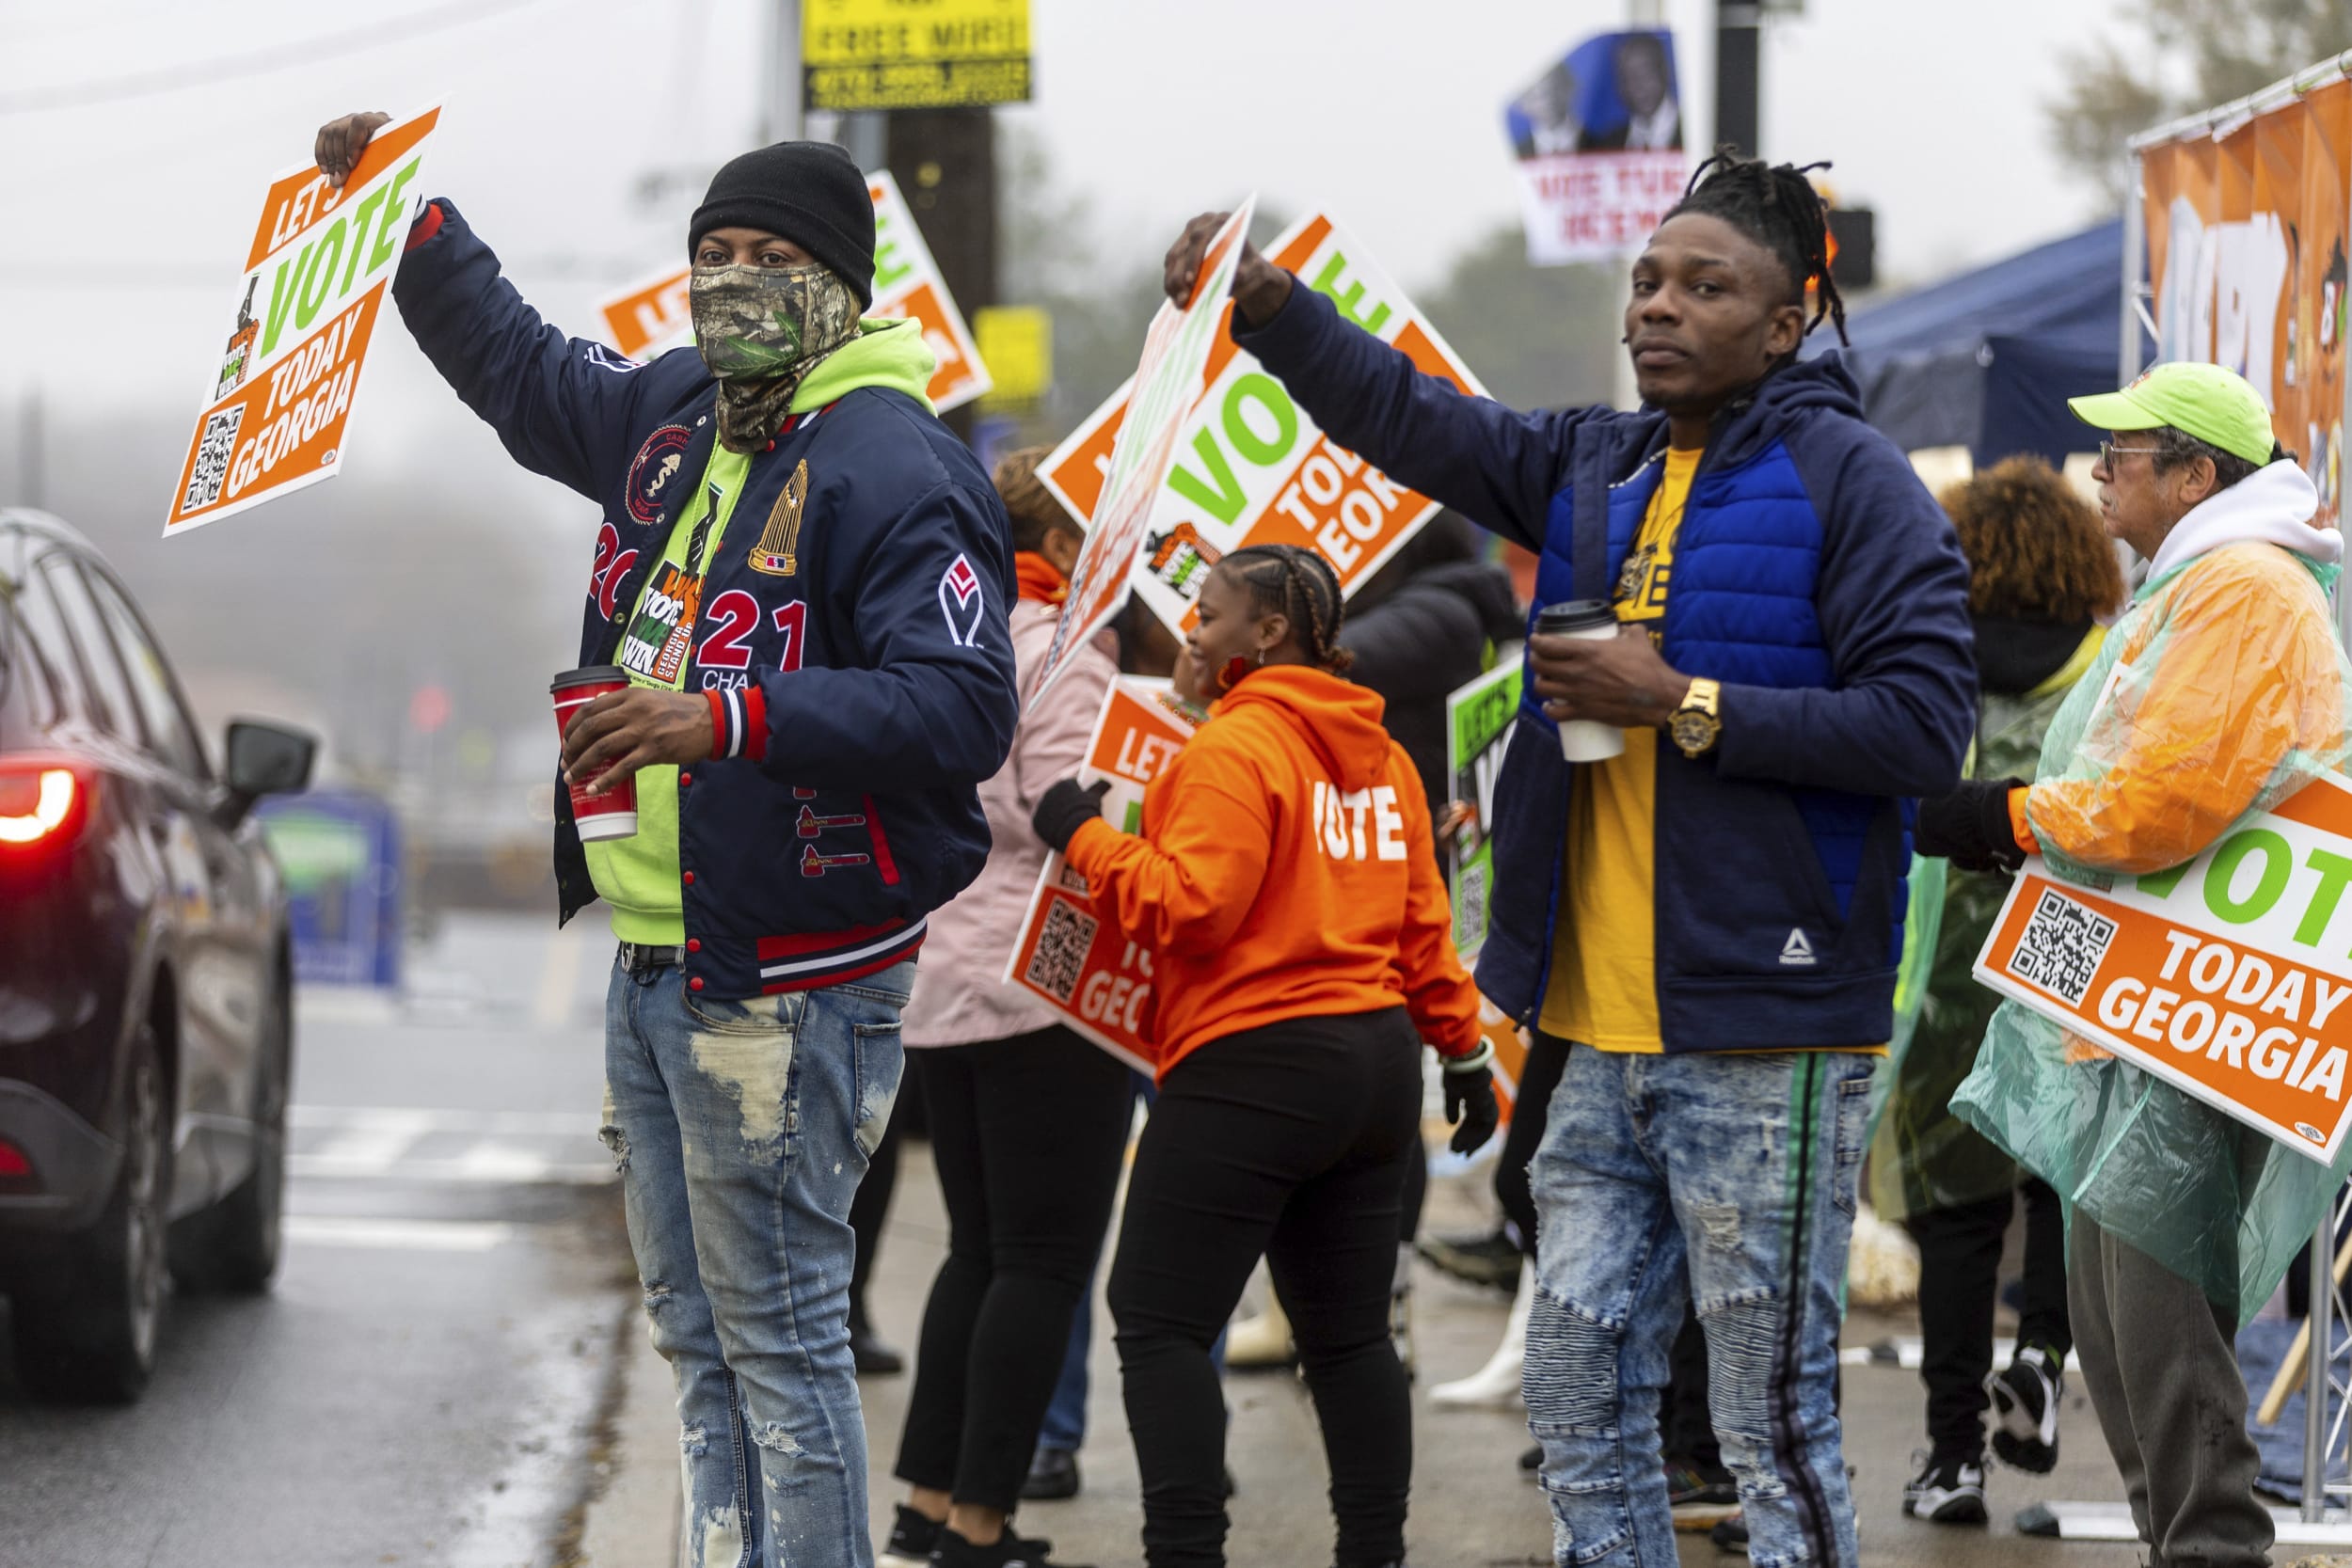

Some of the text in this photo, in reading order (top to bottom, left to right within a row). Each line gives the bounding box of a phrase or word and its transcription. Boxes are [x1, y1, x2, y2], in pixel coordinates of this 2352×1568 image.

[260, 153, 421, 360] VOTE
[262, 301, 365, 420] TODAY
[1167, 250, 1391, 527] VOE
[227, 362, 355, 498] GEORGIA
[658, 626, 683, 675] GEORGIA
[665, 640, 686, 678] STAND
[683, 622, 693, 639] UP
[696, 590, 807, 673] 21
[703, 670, 749, 691] CHA
[1114, 727, 1185, 784] LET
[2136, 828, 2352, 959] OT
[2159, 928, 2352, 1032] TODAY
[2098, 976, 2349, 1102] GEORGIA
